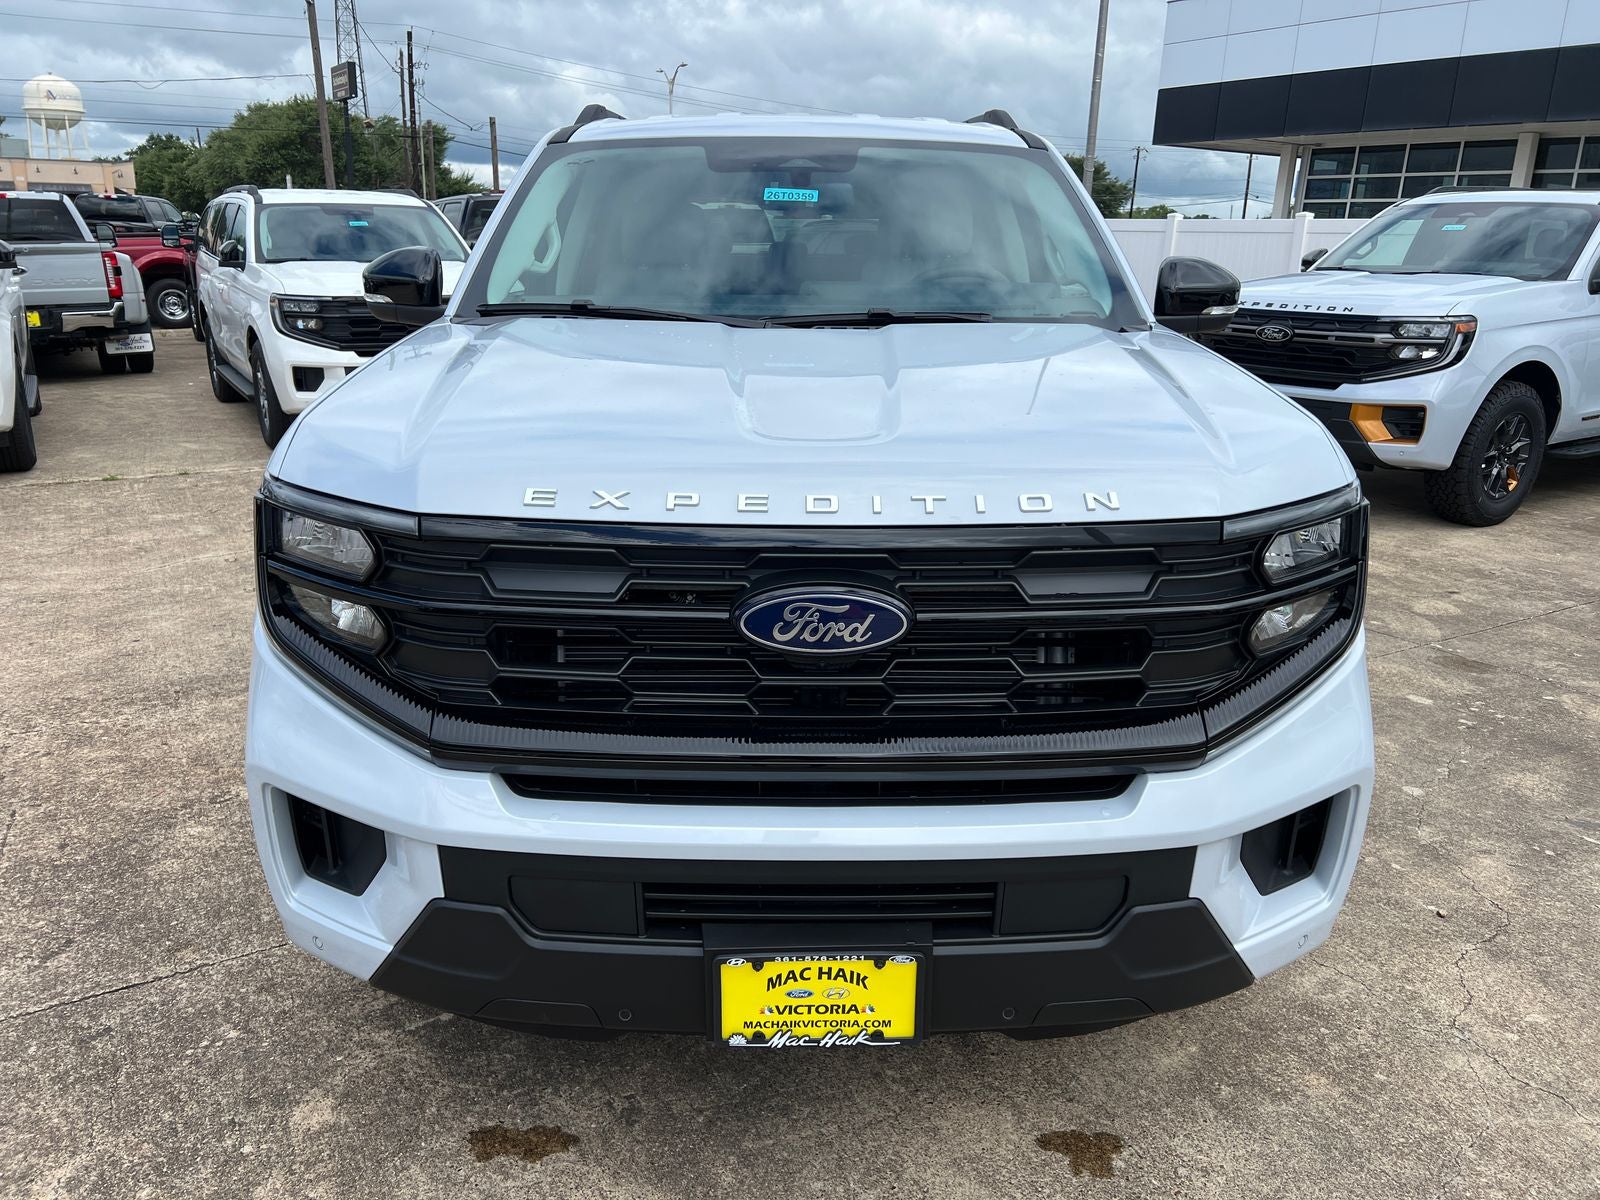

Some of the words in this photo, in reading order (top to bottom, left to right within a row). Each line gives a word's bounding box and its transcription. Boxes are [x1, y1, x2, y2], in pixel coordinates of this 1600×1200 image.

[767, 191, 814, 200] 26T0359
[31, 277, 97, 286] DUTY
[1237, 300, 1355, 313] XPEDITION
[522, 487, 1121, 515] EXPEDITION
[772, 602, 877, 645] Ford
[766, 966, 812, 992] MAC
[817, 966, 869, 991] HAIK
[788, 989, 811, 998] Ford
[774, 1004, 860, 1016] VICTORIA
[743, 1019, 892, 1029] MACHAIKVICTORIA.COM
[767, 1030, 817, 1048] Mac
[818, 1030, 880, 1048] Haik
